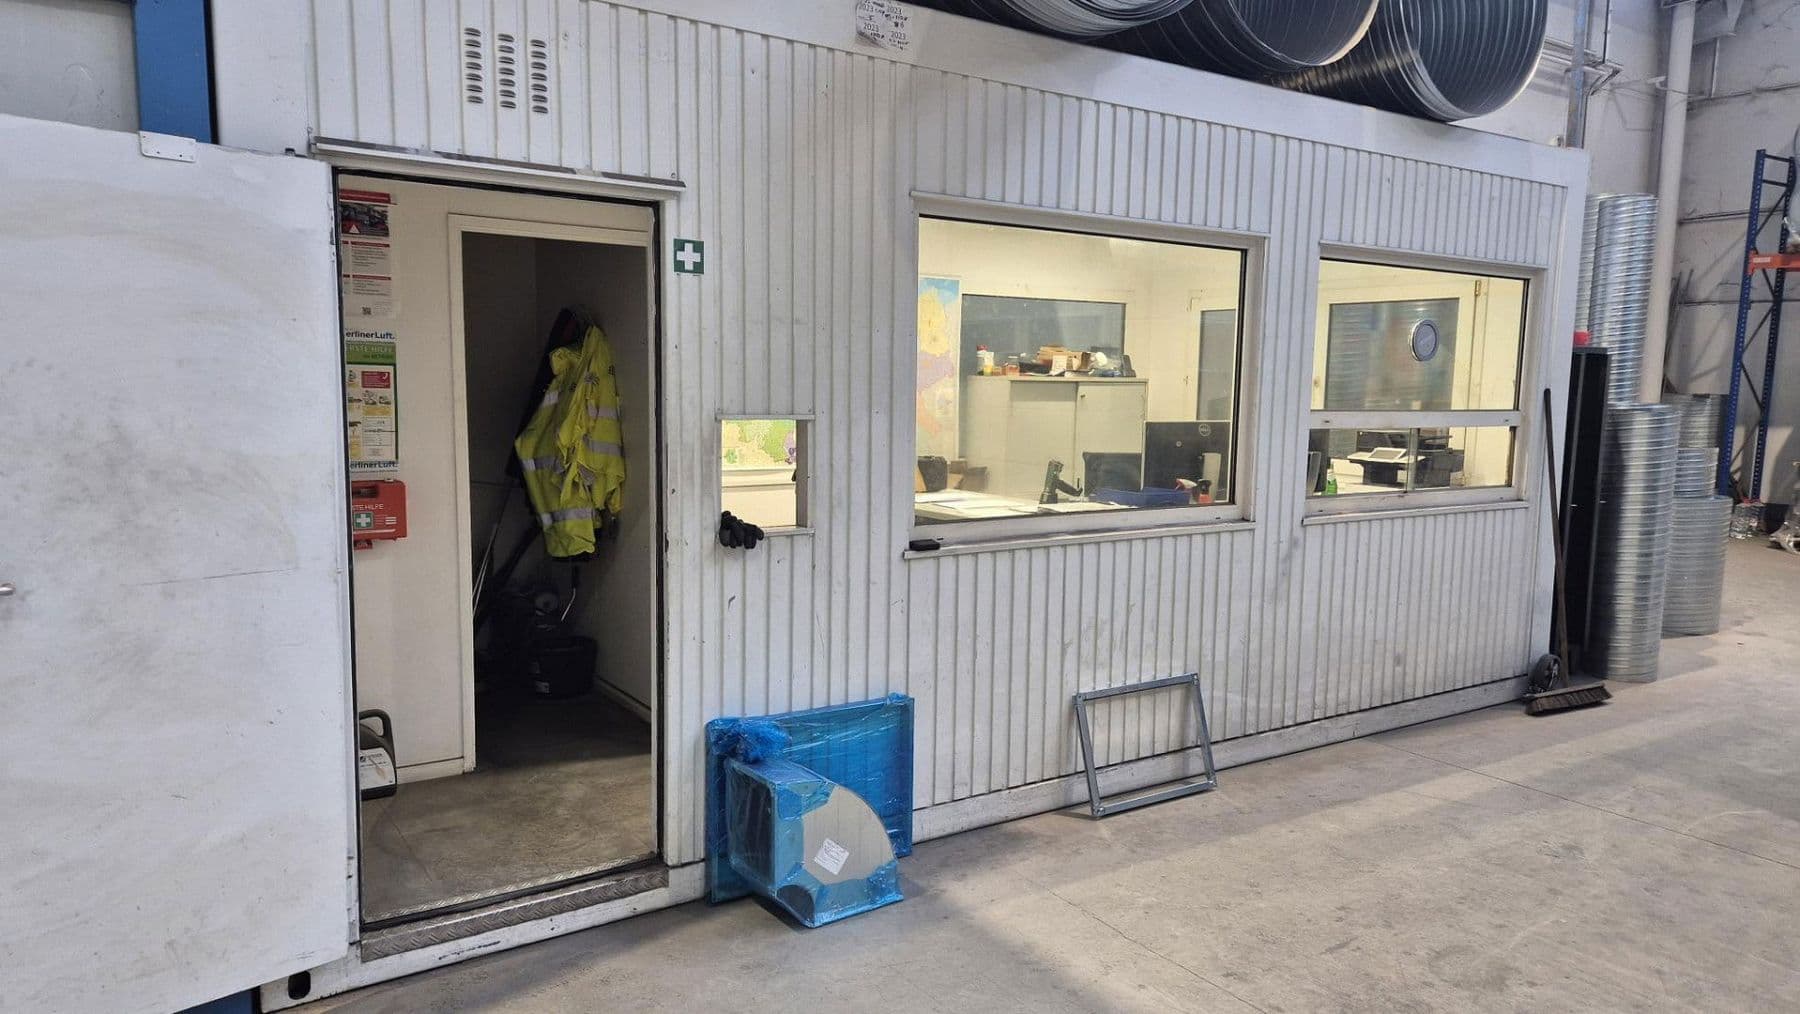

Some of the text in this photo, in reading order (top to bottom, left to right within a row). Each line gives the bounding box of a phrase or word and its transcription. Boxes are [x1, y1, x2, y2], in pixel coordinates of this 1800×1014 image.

[864, 22, 879, 32] 2023
[891, 31, 906, 40] 2023
[346, 331, 396, 339] erlinerLuft.
[350, 461, 398, 469] erlinerLuft.
